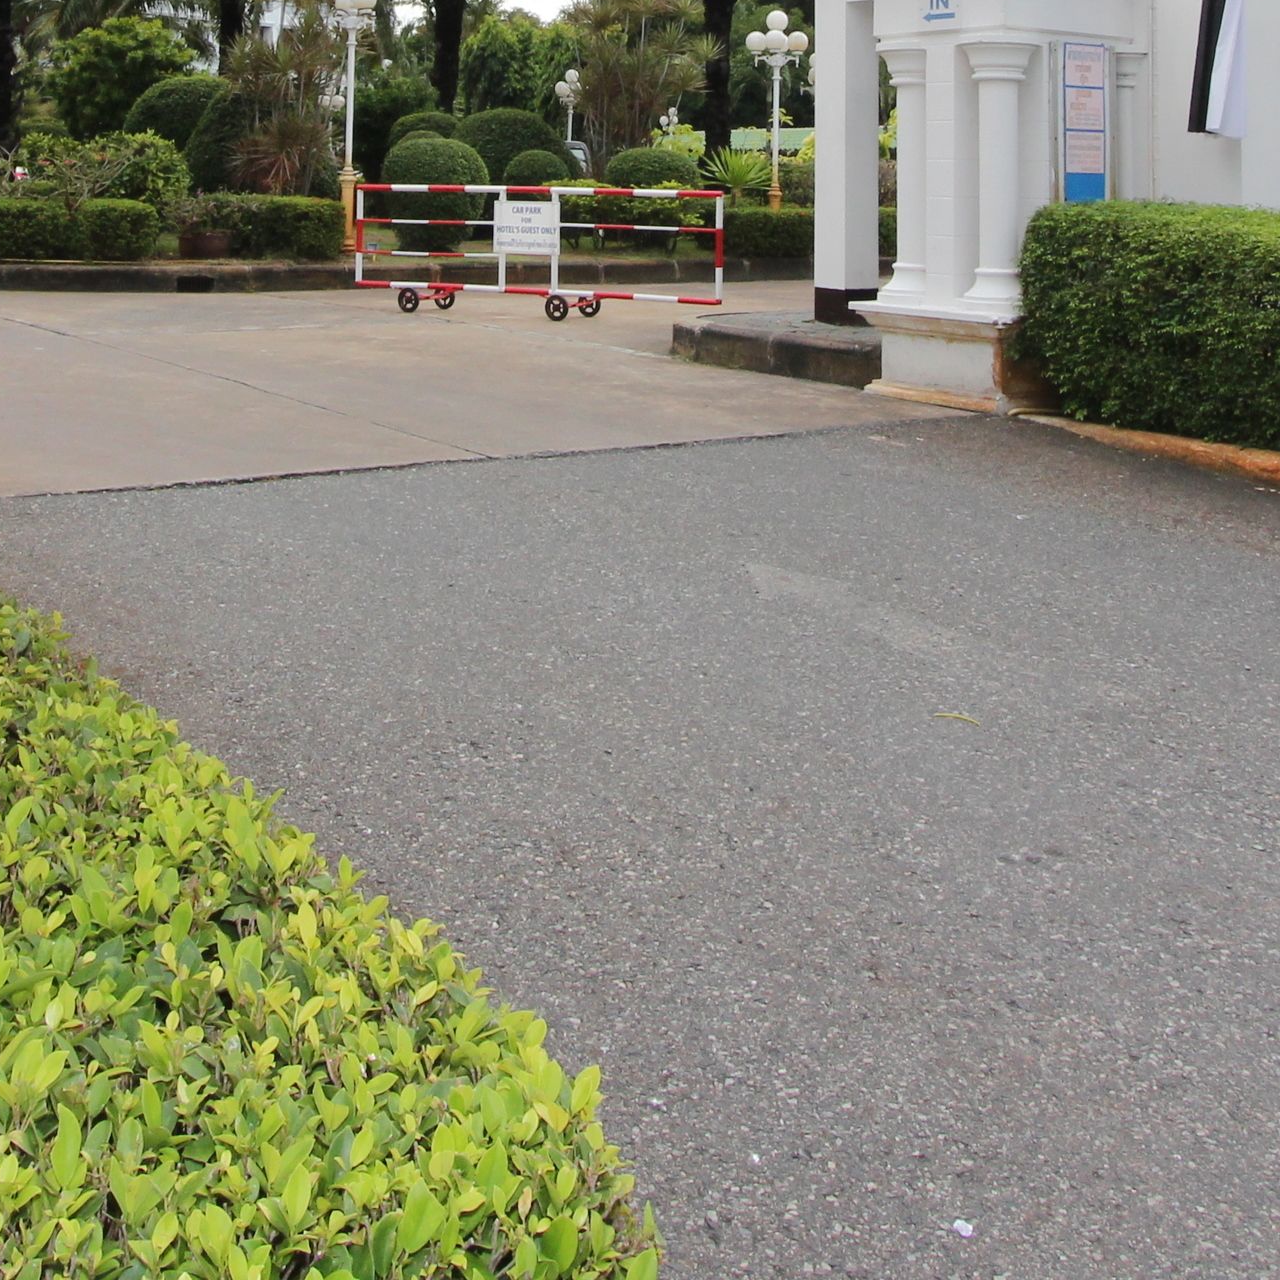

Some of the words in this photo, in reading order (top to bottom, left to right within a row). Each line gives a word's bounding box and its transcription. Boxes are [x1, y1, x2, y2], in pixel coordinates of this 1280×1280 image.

[512, 206, 524, 214] CAR
[525, 206, 542, 215] PARK
[521, 226, 539, 234] GUEST
